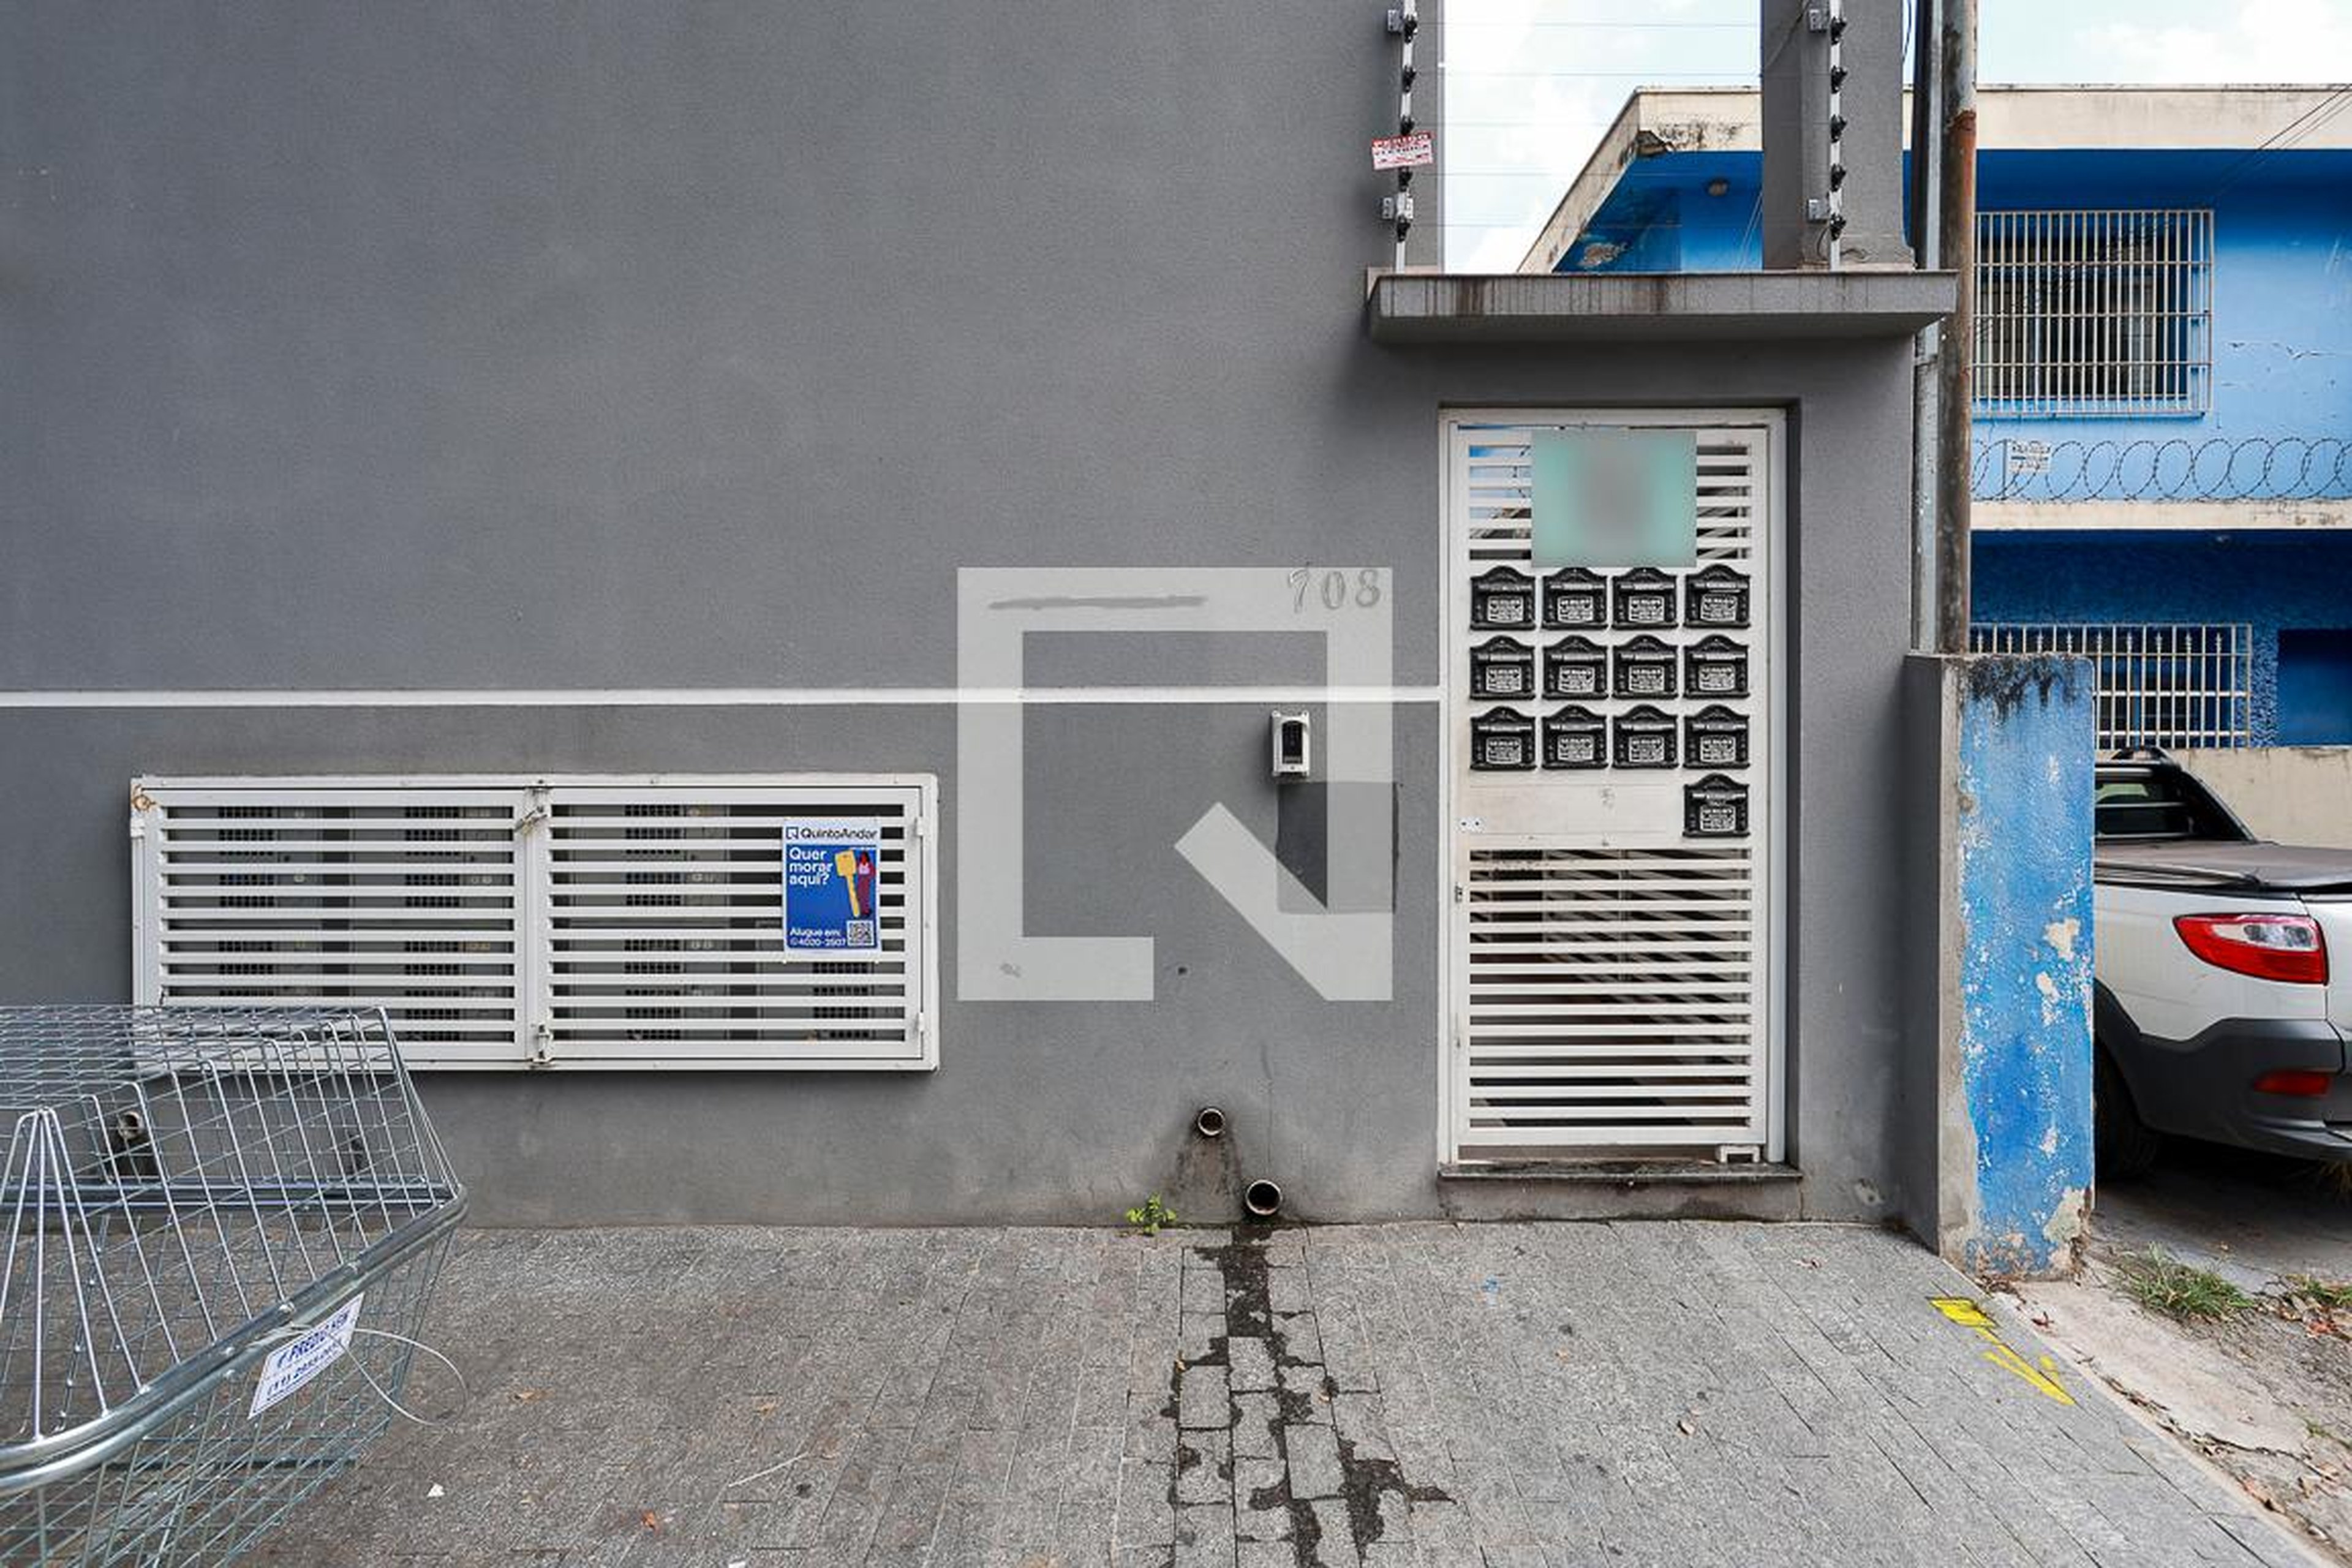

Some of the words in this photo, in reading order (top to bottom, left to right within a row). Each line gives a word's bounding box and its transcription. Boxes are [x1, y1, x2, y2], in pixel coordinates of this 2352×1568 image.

[1287, 567, 1381, 614] 708
[801, 827, 877, 840] QuintoAndar
[789, 848, 827, 860] Quer
[790, 862, 833, 872] morar
[790, 873, 829, 886] aqui?
